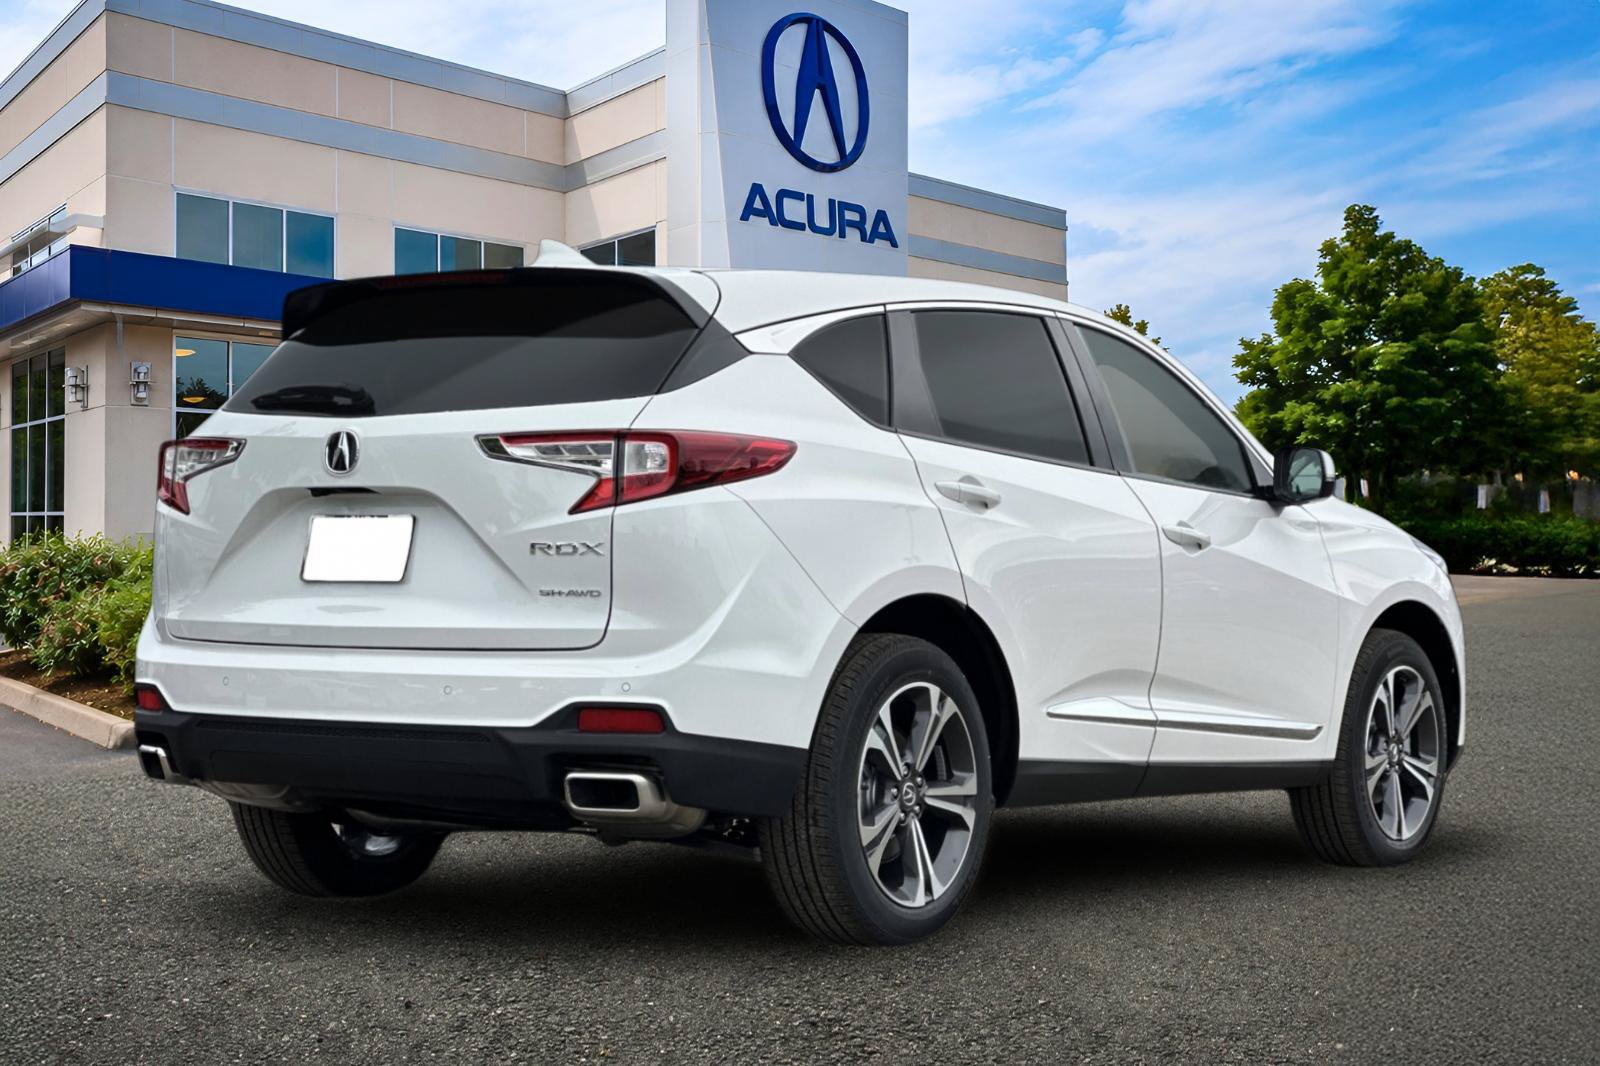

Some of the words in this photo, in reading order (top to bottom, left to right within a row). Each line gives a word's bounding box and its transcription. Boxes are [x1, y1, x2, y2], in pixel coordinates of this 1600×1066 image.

[739, 182, 899, 249] ACURA
[529, 542, 605, 556] RDX
[539, 589, 602, 598] SH-AWD
